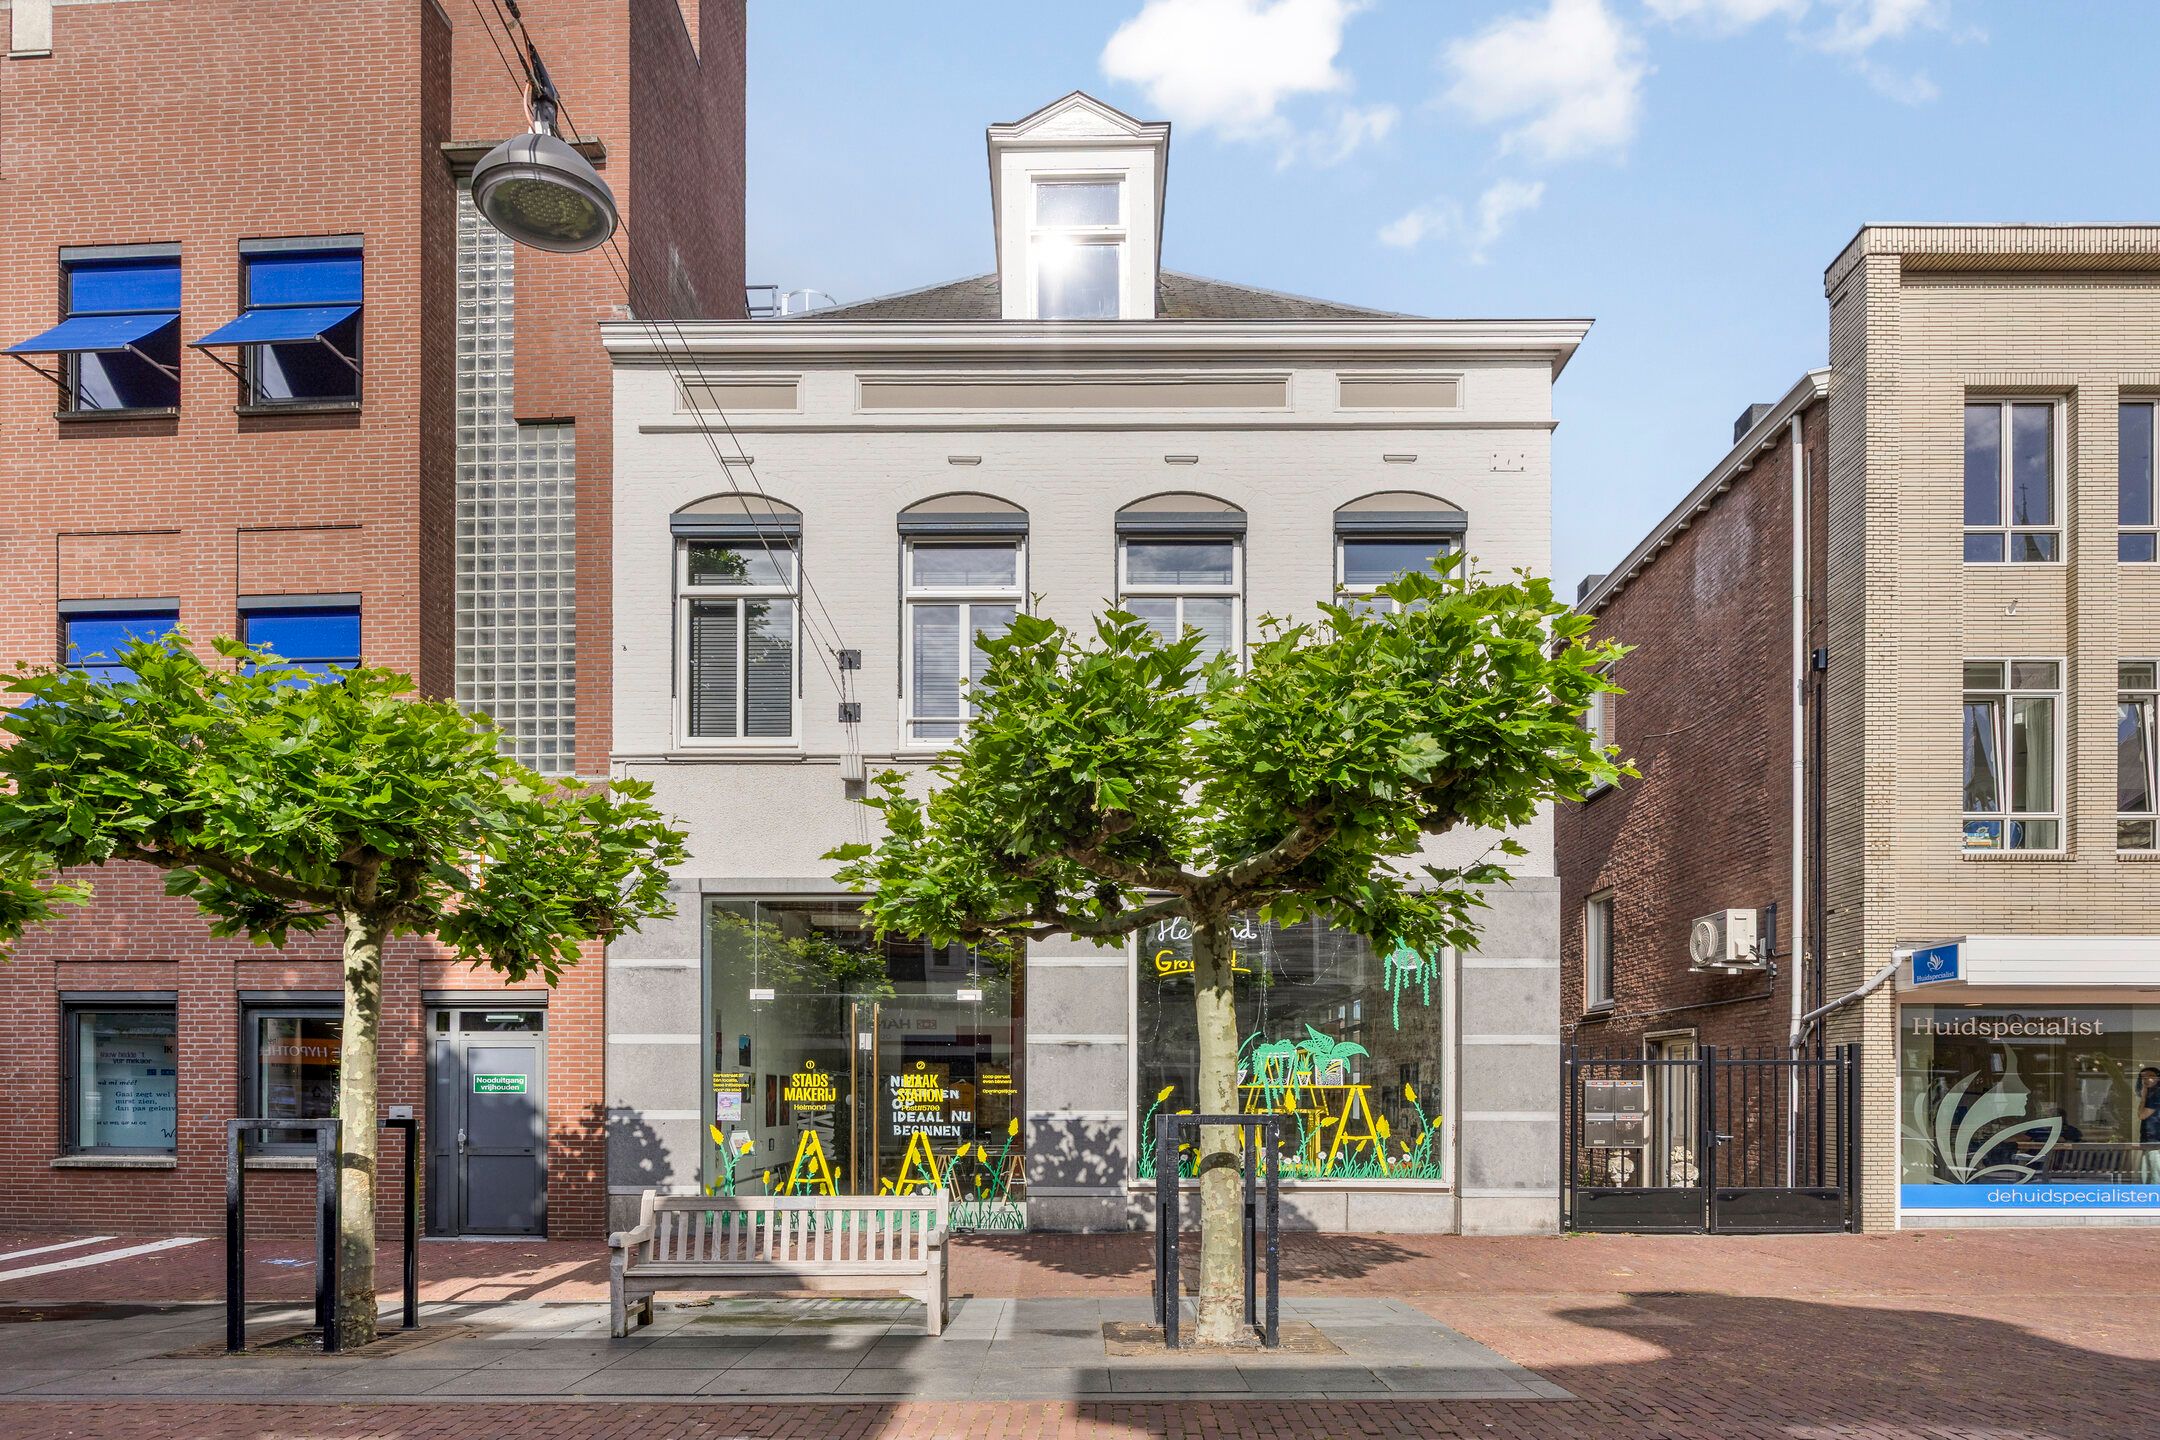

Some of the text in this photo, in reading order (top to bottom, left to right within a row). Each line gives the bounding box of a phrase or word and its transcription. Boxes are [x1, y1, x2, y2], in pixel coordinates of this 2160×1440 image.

[1157, 917, 1258, 942] Hend
[1916, 971, 1955, 982] Huidspecialist
[1912, 1017, 2104, 1041] Huidspecialist
[476, 1077, 525, 1085] Nooduitgang
[792, 1073, 829, 1087] STADS
[903, 1074, 939, 1088] MAAK
[784, 1088, 837, 1102] MAKERIJ
[897, 1088, 944, 1102] STATION
[892, 1110, 971, 1123] IDEAAL NU
[893, 1124, 961, 1137] BEGINNEN
[1987, 1189, 2160, 1205] dehuidspecialisten
